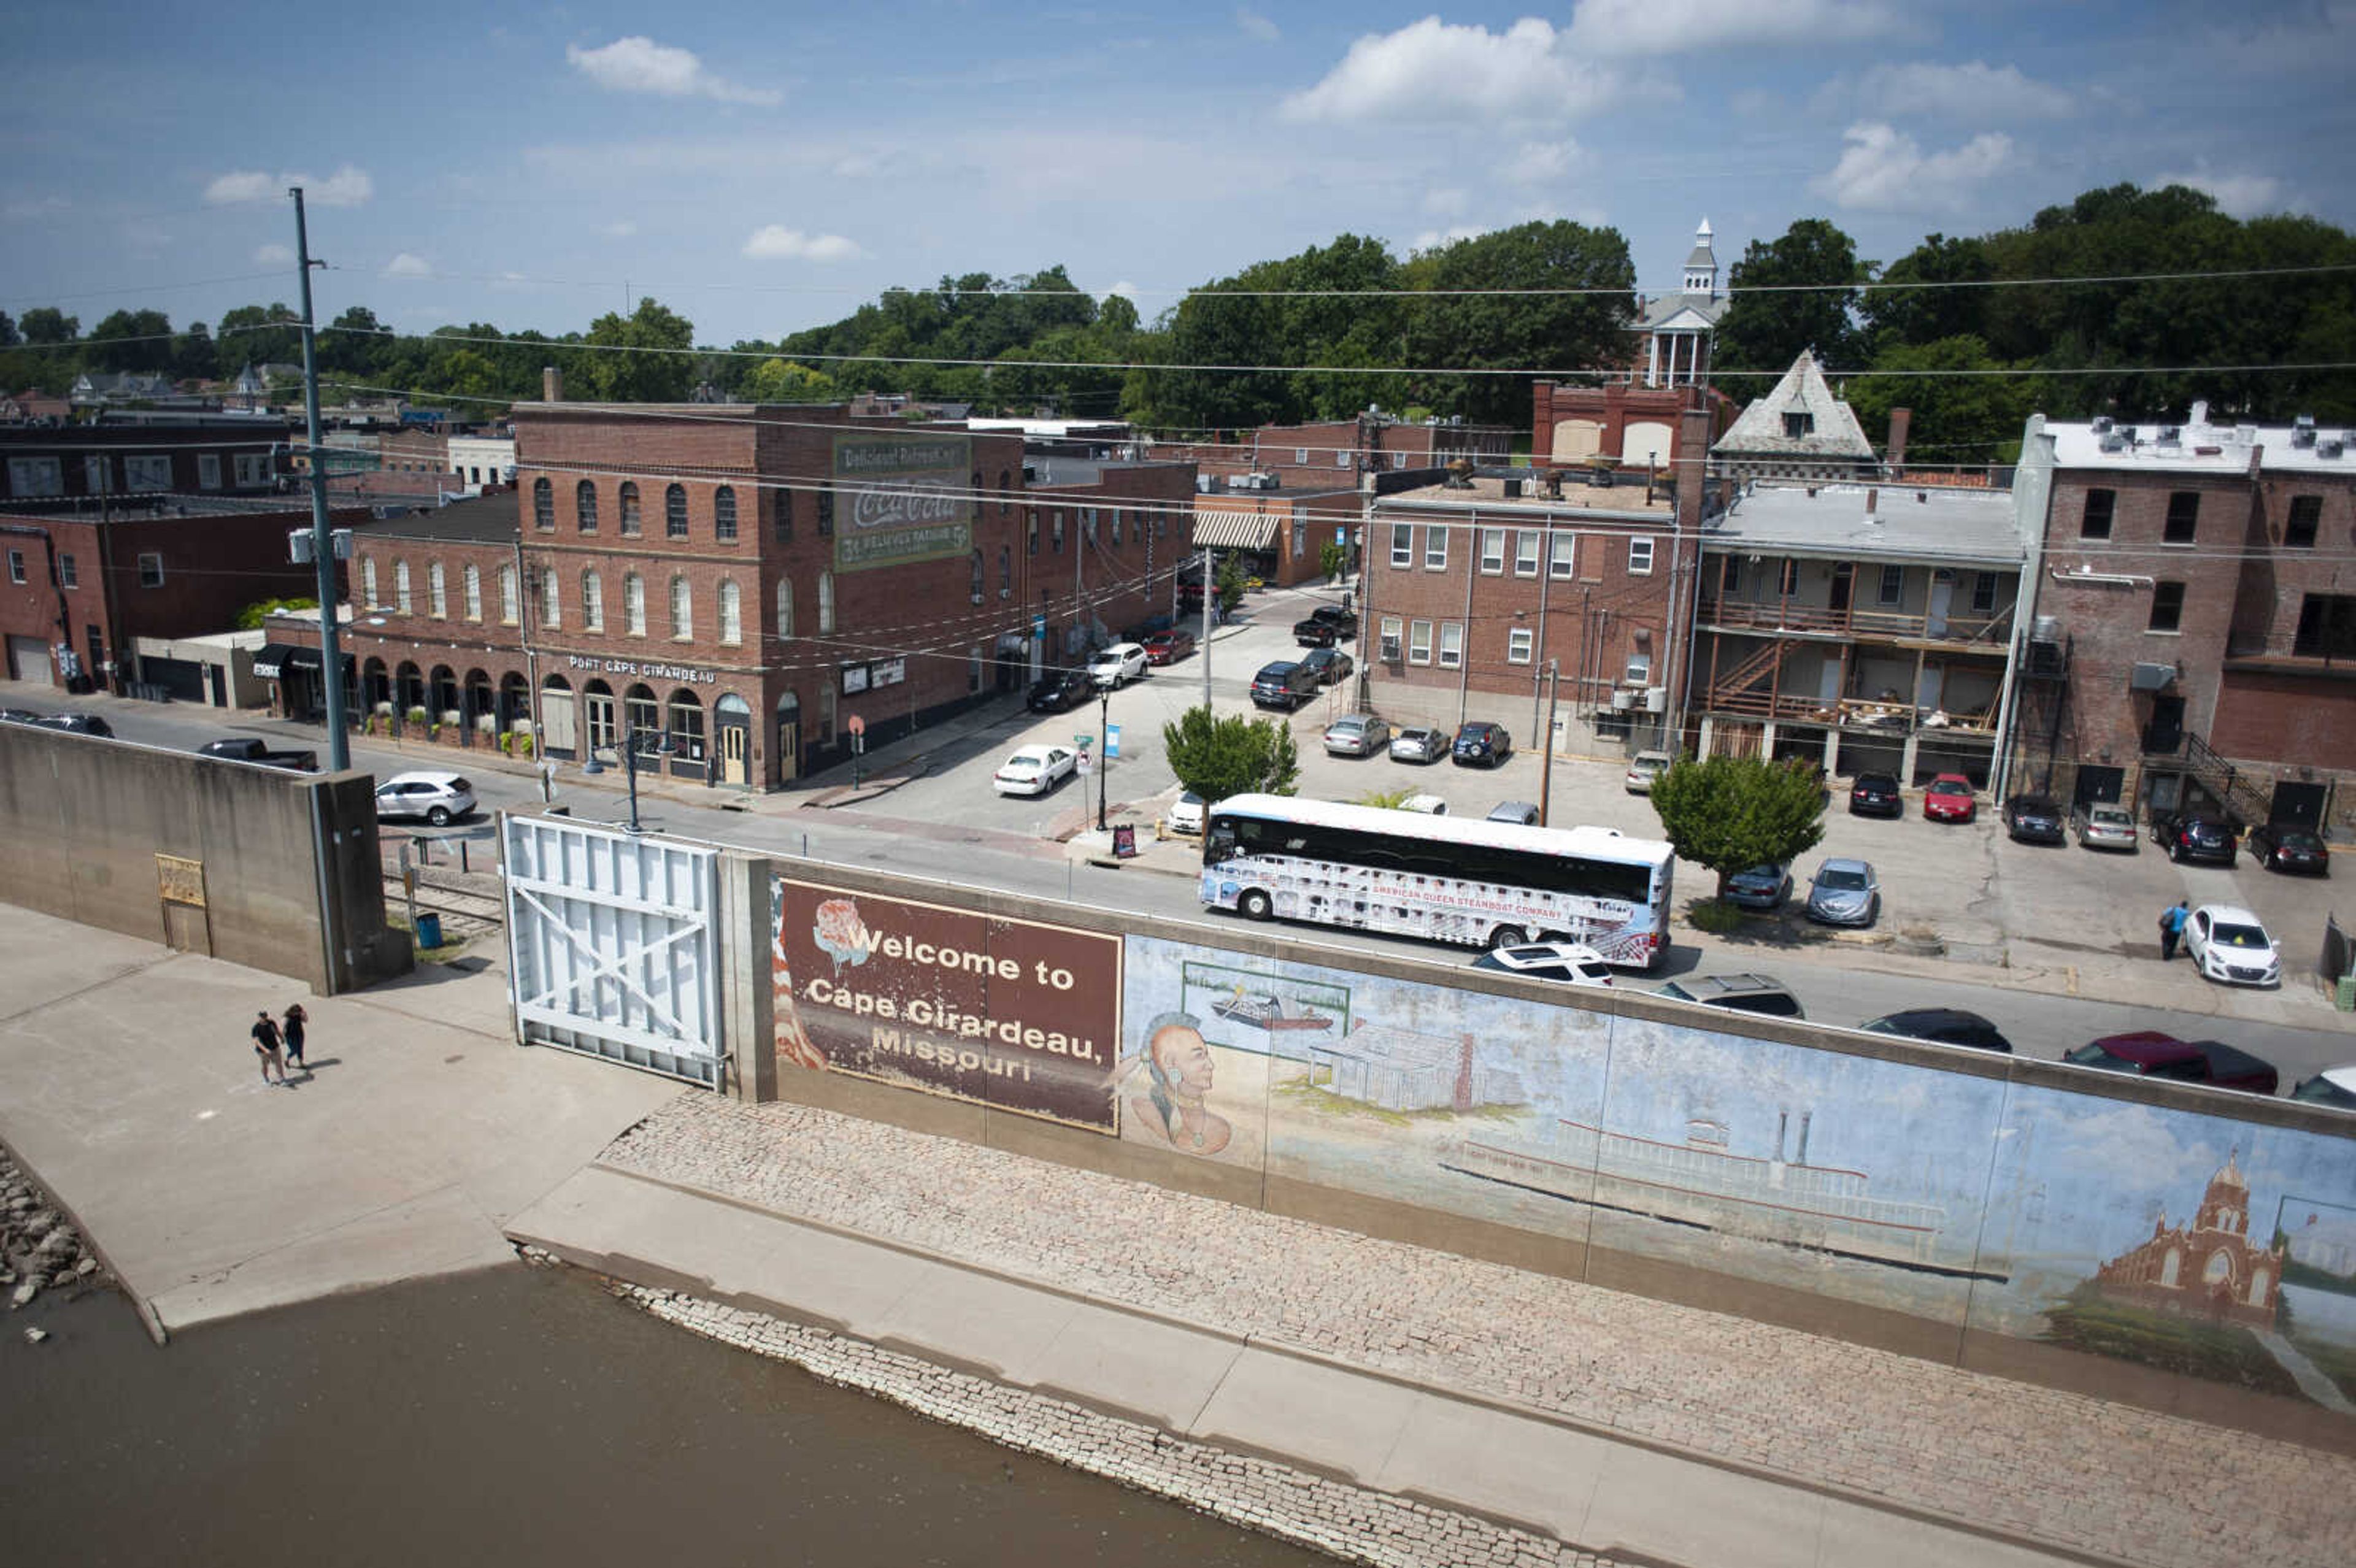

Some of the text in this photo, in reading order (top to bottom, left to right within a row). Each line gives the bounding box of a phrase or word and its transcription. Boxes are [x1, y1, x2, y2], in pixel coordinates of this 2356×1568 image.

[569, 655, 715, 683] PORT CAPE GIRARDEAU
[1372, 885, 1561, 920] AMERICAN QUEEN STEAMBOAT COMPANY
[848, 926, 1074, 990] Welcome to
[809, 978, 1102, 1065] Cape Girardeau,
[872, 1026, 1031, 1082] Missouri
